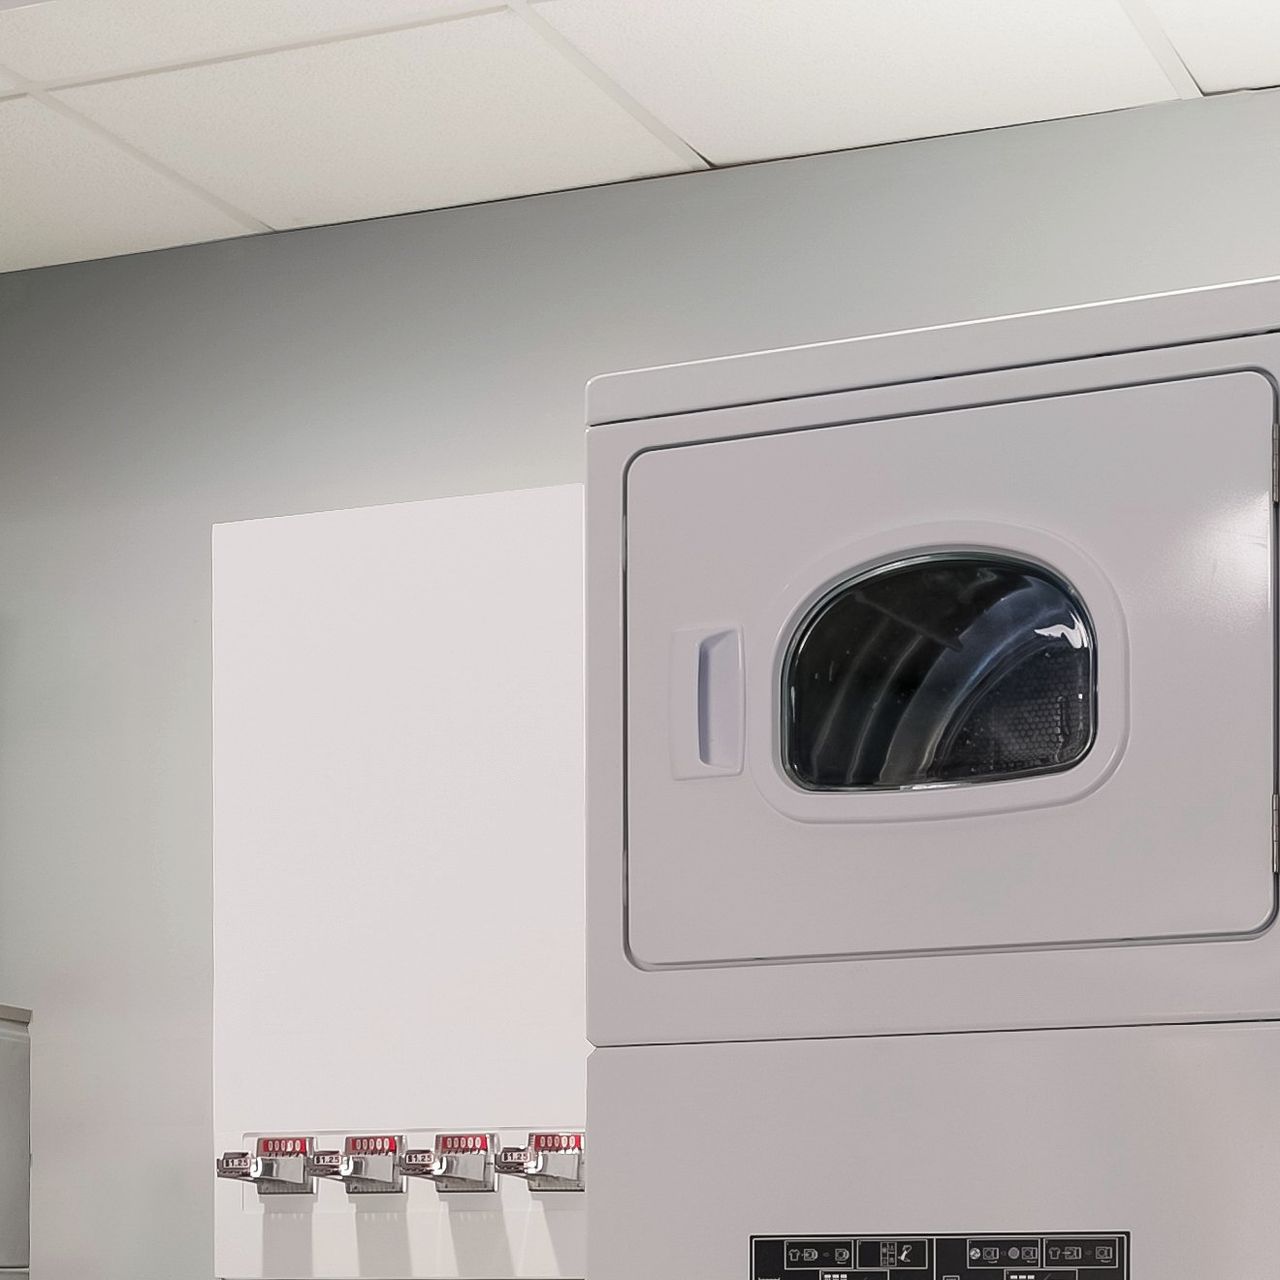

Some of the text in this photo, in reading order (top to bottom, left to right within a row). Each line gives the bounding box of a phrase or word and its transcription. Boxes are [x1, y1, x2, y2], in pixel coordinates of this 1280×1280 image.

[316, 1156, 340, 1164] $1.25
[408, 1154, 433, 1163] $1.25
[503, 1153, 529, 1161] $1.25
[224, 1159, 249, 1167] $1.25
